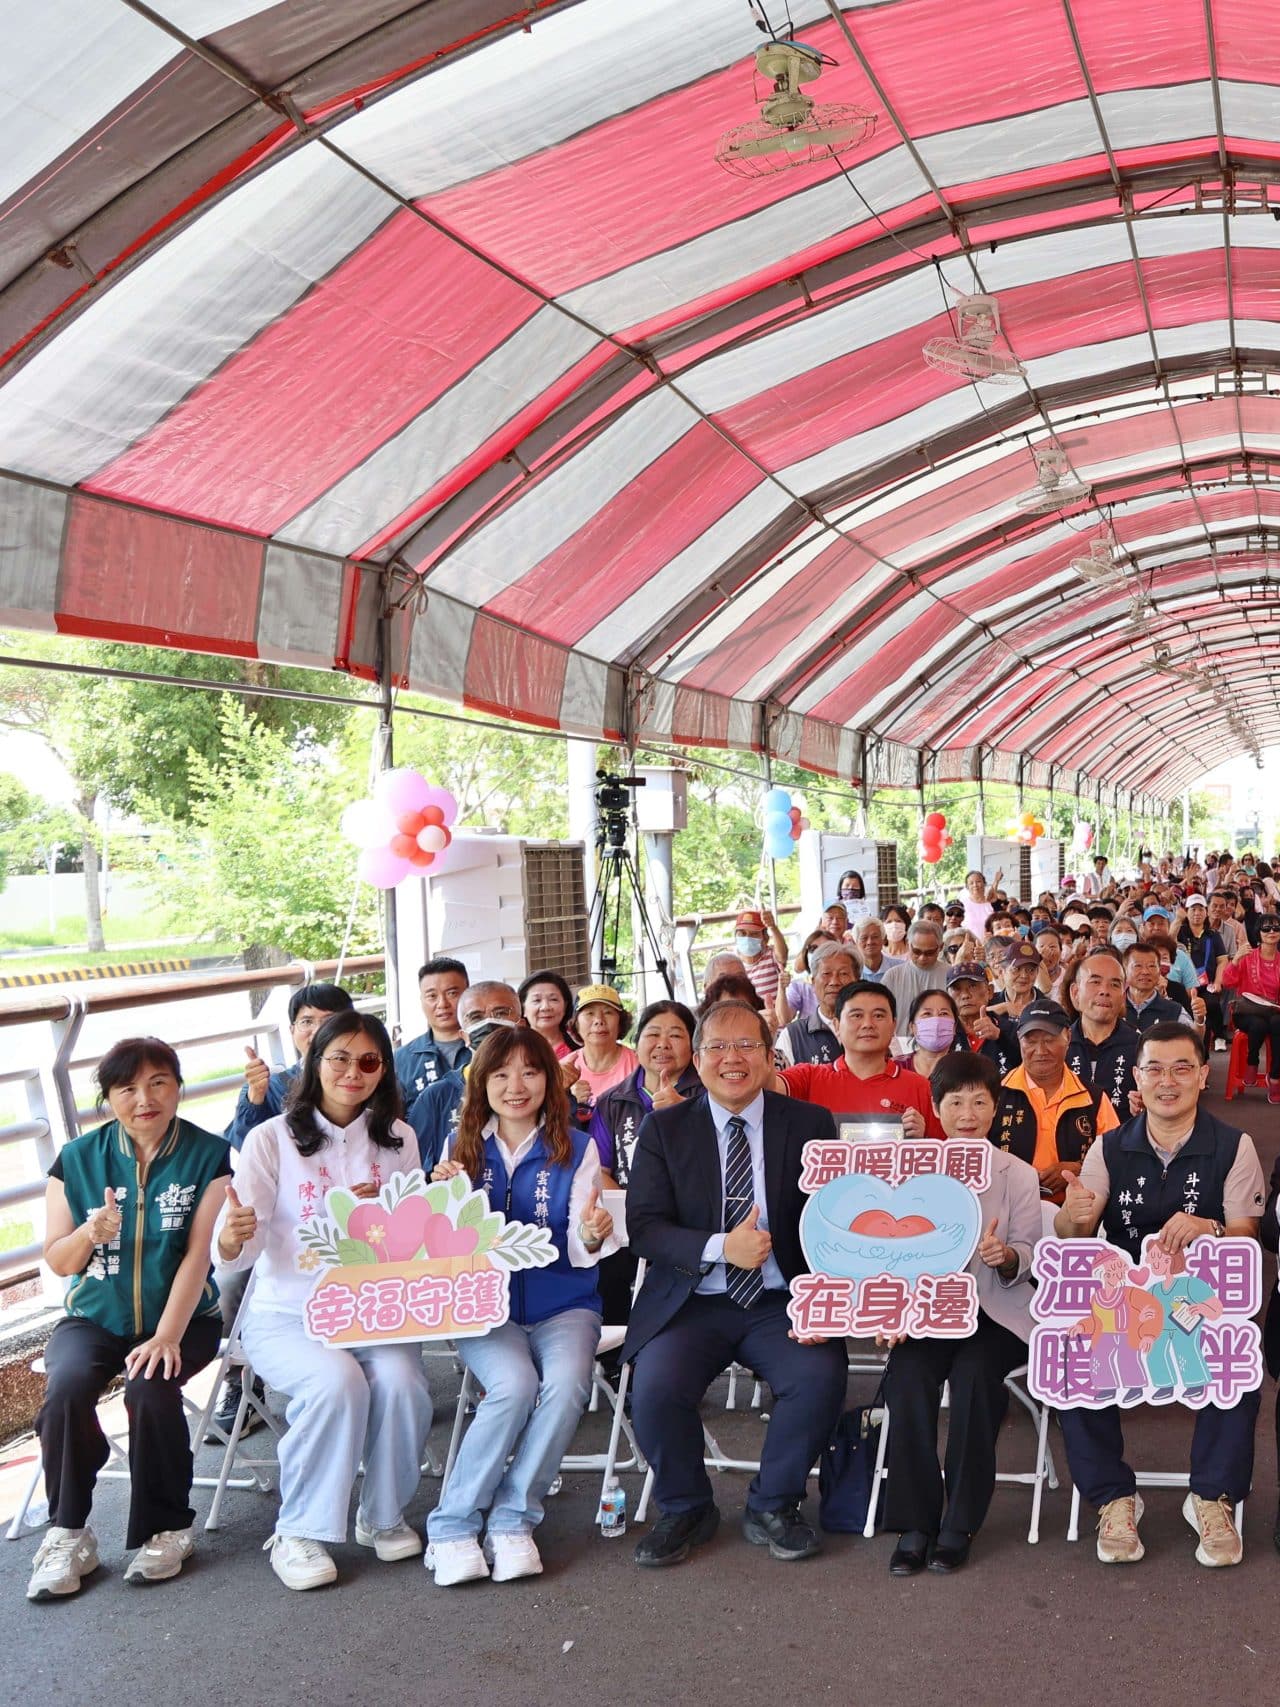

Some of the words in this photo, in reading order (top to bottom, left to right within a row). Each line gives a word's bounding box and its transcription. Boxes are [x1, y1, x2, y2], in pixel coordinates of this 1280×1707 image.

[1110, 1054, 1127, 1107] 斗六市公所
[807, 1146, 984, 1186] 溫暖照顧
[1134, 1176, 1147, 1205] 市長
[1183, 1171, 1200, 1215] 斗六市
[309, 1271, 504, 1338] 幸福守護
[797, 1277, 971, 1330] 在身邊
[77, 1547, 90, 1563] N
[177, 1533, 191, 1551] N
